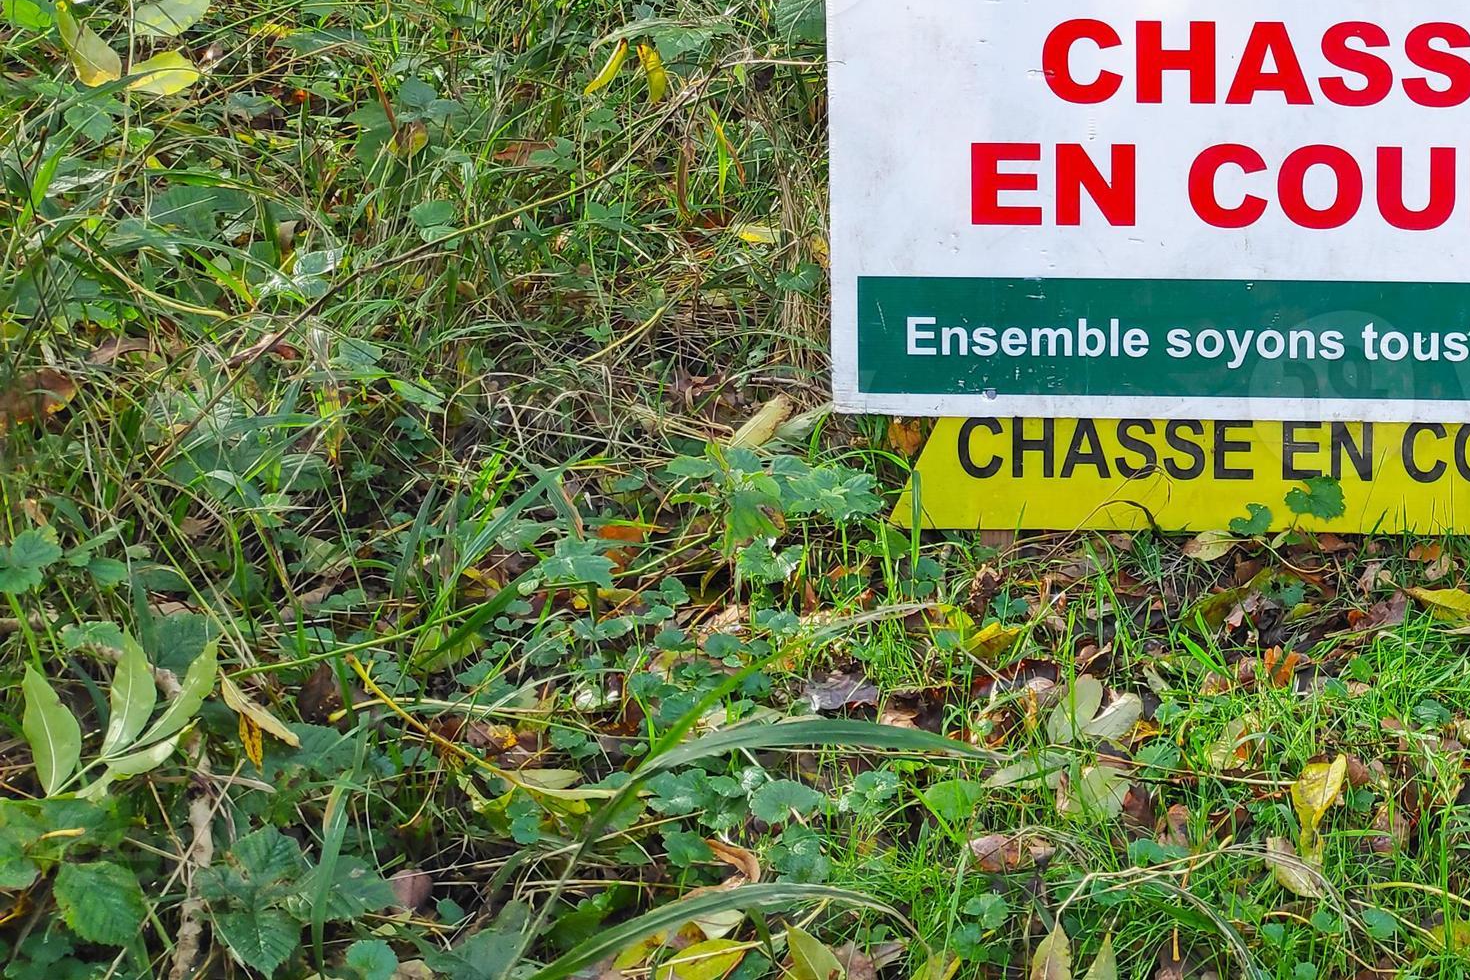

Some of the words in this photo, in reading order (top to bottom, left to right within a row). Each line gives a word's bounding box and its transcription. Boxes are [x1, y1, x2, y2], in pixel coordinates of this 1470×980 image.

[970, 142, 1136, 226] EN
[906, 316, 1149, 358] Ensemble
[1166, 328, 1345, 368] soyons
[1361, 322, 1469, 362] tous
[957, 417, 1254, 480] CHASSE
[1282, 421, 1374, 482] EN
